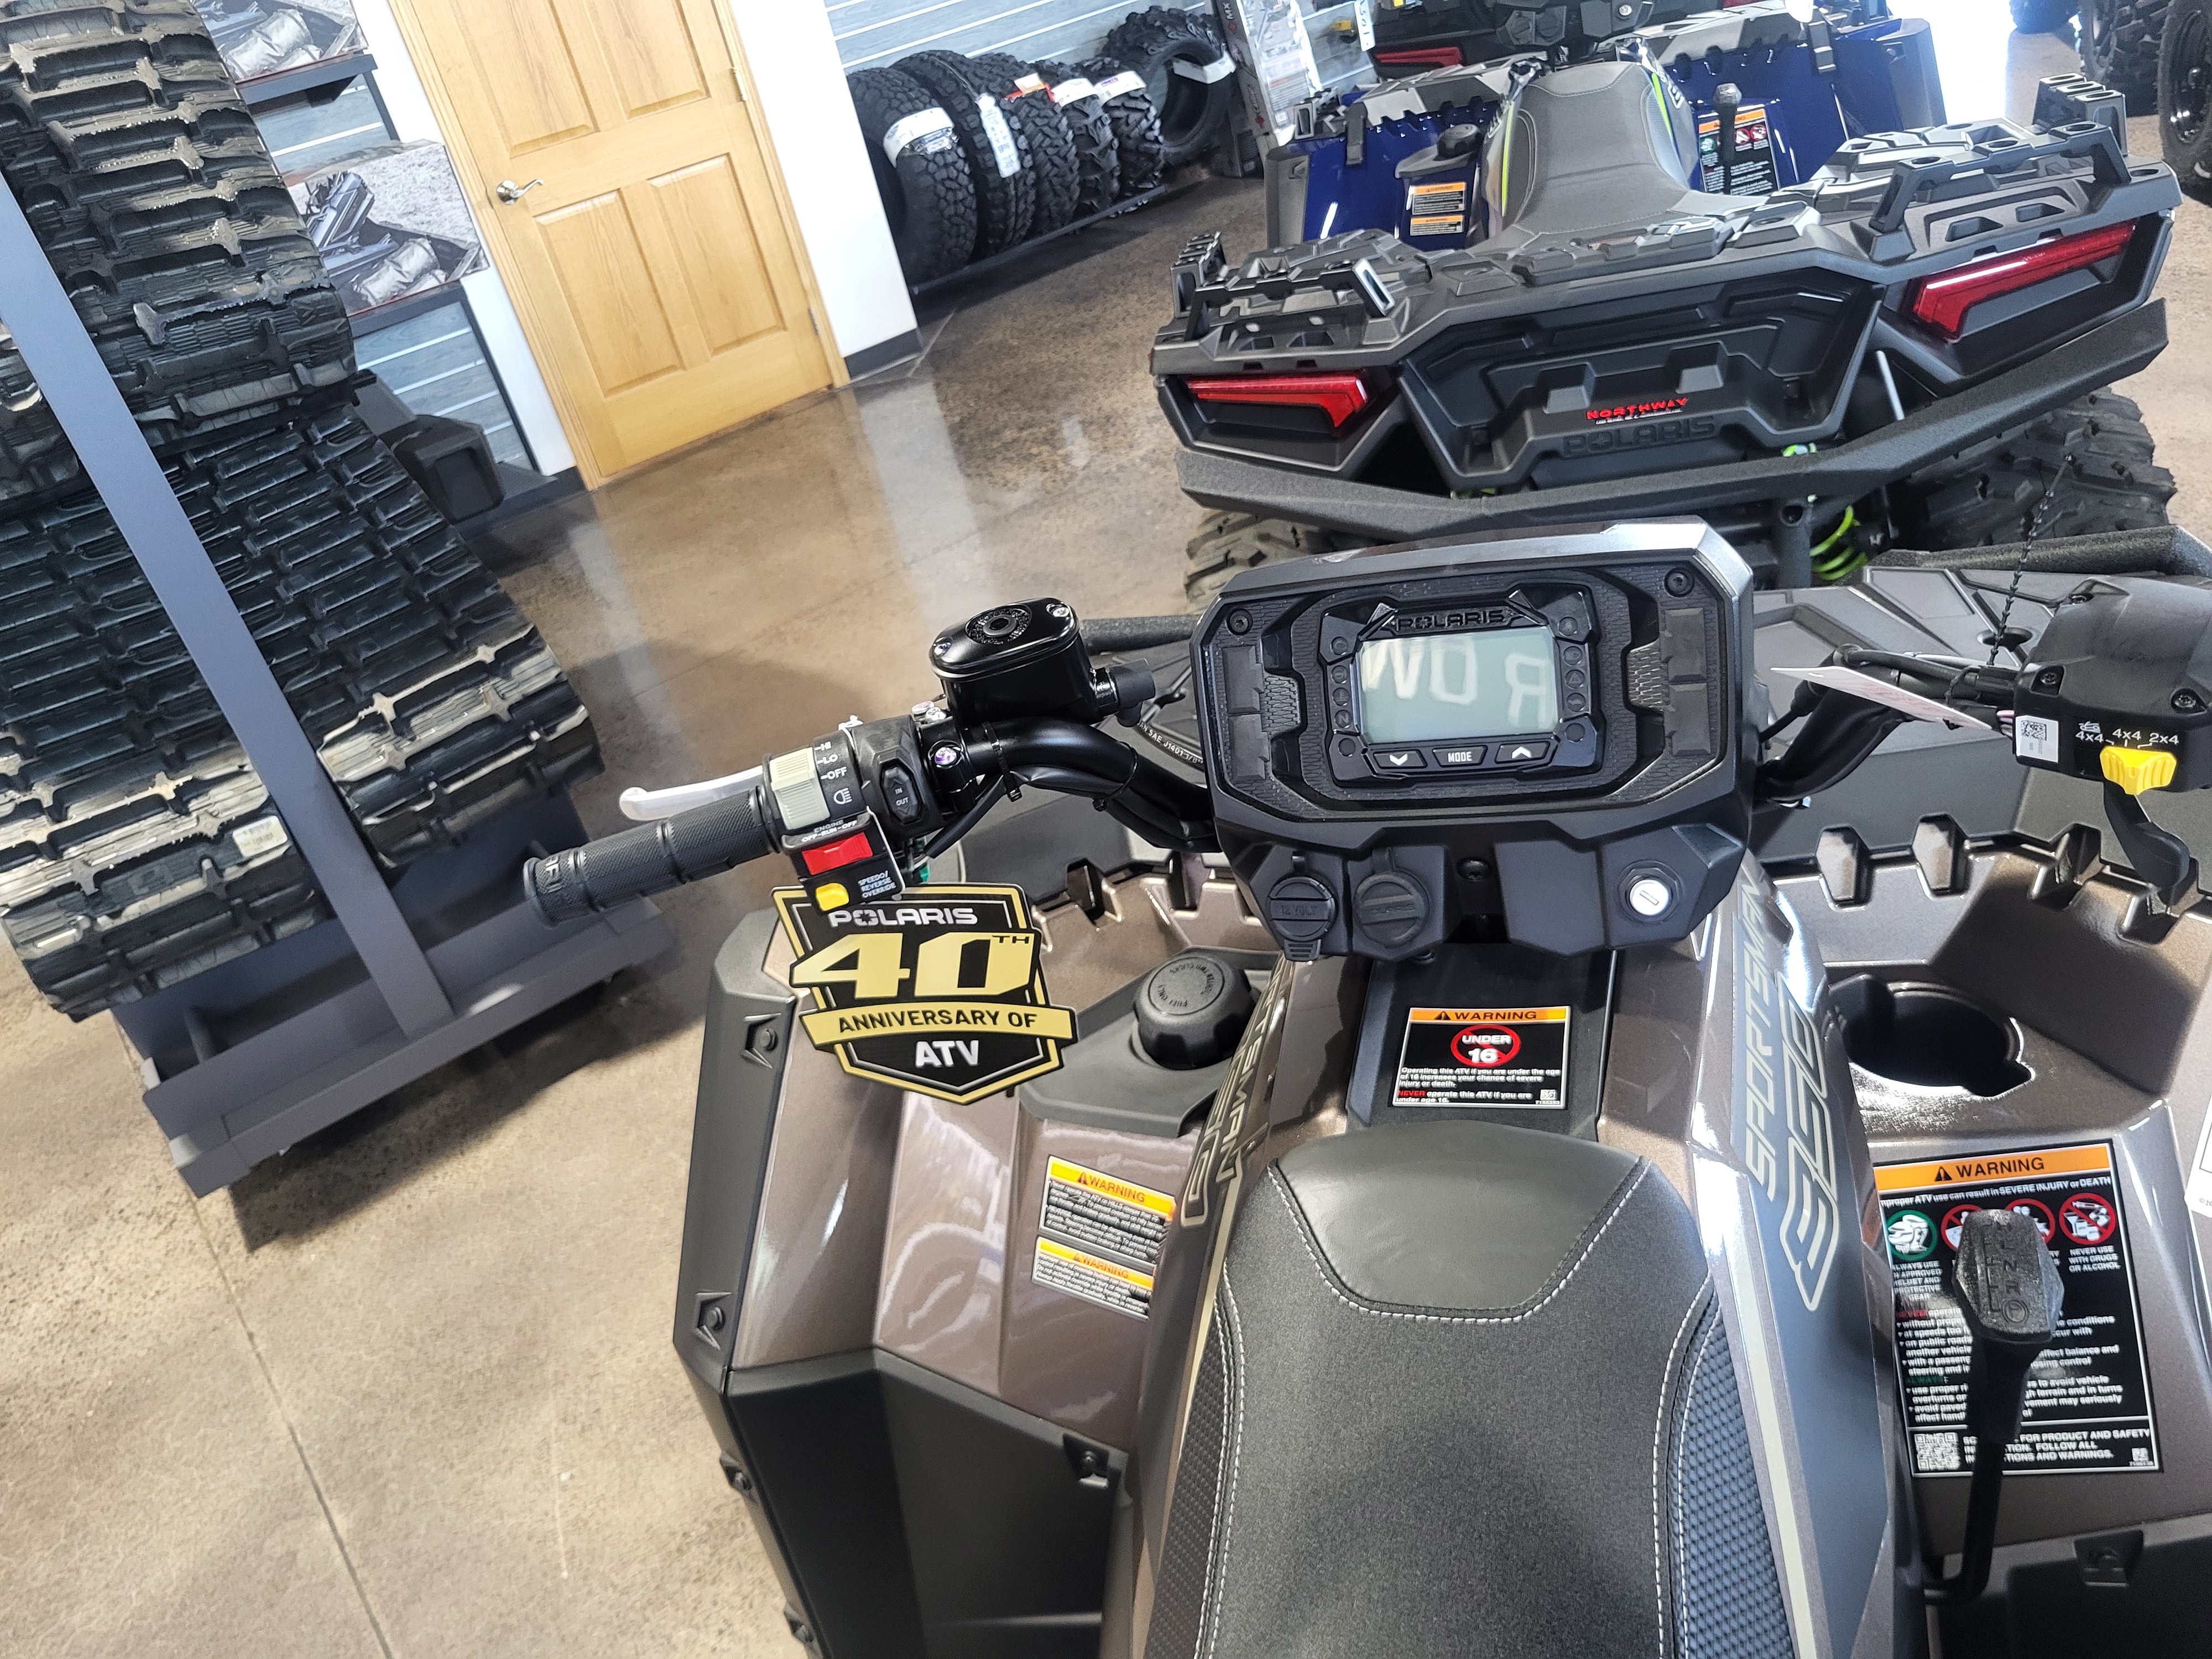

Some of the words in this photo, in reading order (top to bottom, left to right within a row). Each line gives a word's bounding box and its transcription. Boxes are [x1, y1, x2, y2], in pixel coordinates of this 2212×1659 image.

[1586, 397, 1689, 420] NORTHWAY
[1561, 415, 1717, 458] POLARIS
[1396, 609, 1506, 632] POLARIS
[1147, 728, 1164, 743] SAE
[821, 741, 832, 750] HI
[823, 754, 838, 765] LO
[1447, 751, 1472, 763] MODE
[826, 766, 848, 780] OFF
[895, 796, 909, 807] OUT
[813, 819, 844, 833] ENGINE
[860, 877, 893, 893] REVERSE
[861, 882, 898, 899] OVERRIDE
[830, 907, 979, 927] POLARIS
[838, 1009, 1000, 1034] ANNIVERSARY
[1008, 1011, 1037, 1029] OF
[1454, 1011, 1537, 1020] WARNING
[1462, 1035, 1512, 1045] UNDER
[1740, 864, 1776, 1202] SPORTSMAN
[915, 1040, 979, 1068] ATV
[1468, 1048, 1499, 1063] 16
[1494, 1091, 1501, 1099] if
[1955, 1157, 2044, 1178] WARNING
[1089, 1175, 1146, 1203] WARNING
[1914, 1193, 1933, 1204] ATV
[1933, 1193, 1949, 1203] use
[1949, 1191, 1965, 1202] can
[1965, 1188, 1991, 1199] result
[1990, 1188, 1999, 1196] in
[1999, 1183, 2036, 1197] SEVERE
[2036, 1179, 2069, 1193] INJURY
[2070, 1180, 2080, 1189] or
[2079, 1175, 2112, 1187] DEATH
[2069, 1246, 2097, 1256] NEVER
[2097, 1245, 2115, 1254] USE
[1082, 1254, 1130, 1279] WARNING
[1923, 1260, 1941, 1269] USE
[2068, 1256, 2089, 1265] WITH
[2089, 1254, 2119, 1263] DRUGS
[2068, 1264, 2081, 1272] OR
[2081, 1261, 2121, 1272] ALCOHOL
[1901, 1268, 1943, 1278] APPROVED
[1924, 1276, 1942, 1285] AND
[1902, 1319, 1936, 1328] without
[2067, 1316, 2116, 1327] conditions
[1914, 1328, 1947, 1339] speeds
[1947, 1327, 1963, 1336] too
[2072, 1327, 2093, 1336] with
[1905, 1339, 1918, 1348] on
[1918, 1337, 1947, 1348] public
[1947, 1334, 1974, 1345] roads
[1906, 1347, 1940, 1358] another
[1940, 1345, 1973, 1355] vehicle
[1907, 1357, 1927, 1366] with
[2064, 1346, 2100, 1357] balance
[2100, 1344, 2120, 1354] and
[1908, 1366, 1945, 1377] steering
[1945, 1364, 1962, 1374] and
[2059, 1355, 2092, 1367] control
[2038, 1379, 2049, 1388] to
[2049, 1376, 2075, 1387] avoid
[2075, 1374, 2110, 1386] vehicle
[1911, 1386, 1929, 1396] use
[1929, 1384, 1960, 1396] proper
[2037, 1386, 2068, 1397] terrain
[2068, 1385, 2086, 1396] and
[2086, 1385, 2098, 1394] in
[2098, 1384, 2124, 1394] turns
[1912, 1394, 1956, 1406] overturns
[2058, 1397, 2079, 1407] may
[2079, 1393, 2124, 1405] seriously
[1914, 1403, 1940, 1414] avoid
[1915, 1413, 1940, 1423] affect
[2019, 1432, 2041, 1443] FOR
[2041, 1431, 2089, 1442] PRODUCT
[2089, 1430, 2112, 1440] AND
[2112, 1428, 2150, 1439] SAFETY
[2036, 1441, 2077, 1452] FOLLOW
[2078, 1440, 2098, 1450] ALL
[2036, 1451, 2057, 1461] AND
[2058, 1449, 2115, 1461] WARNINGS.
